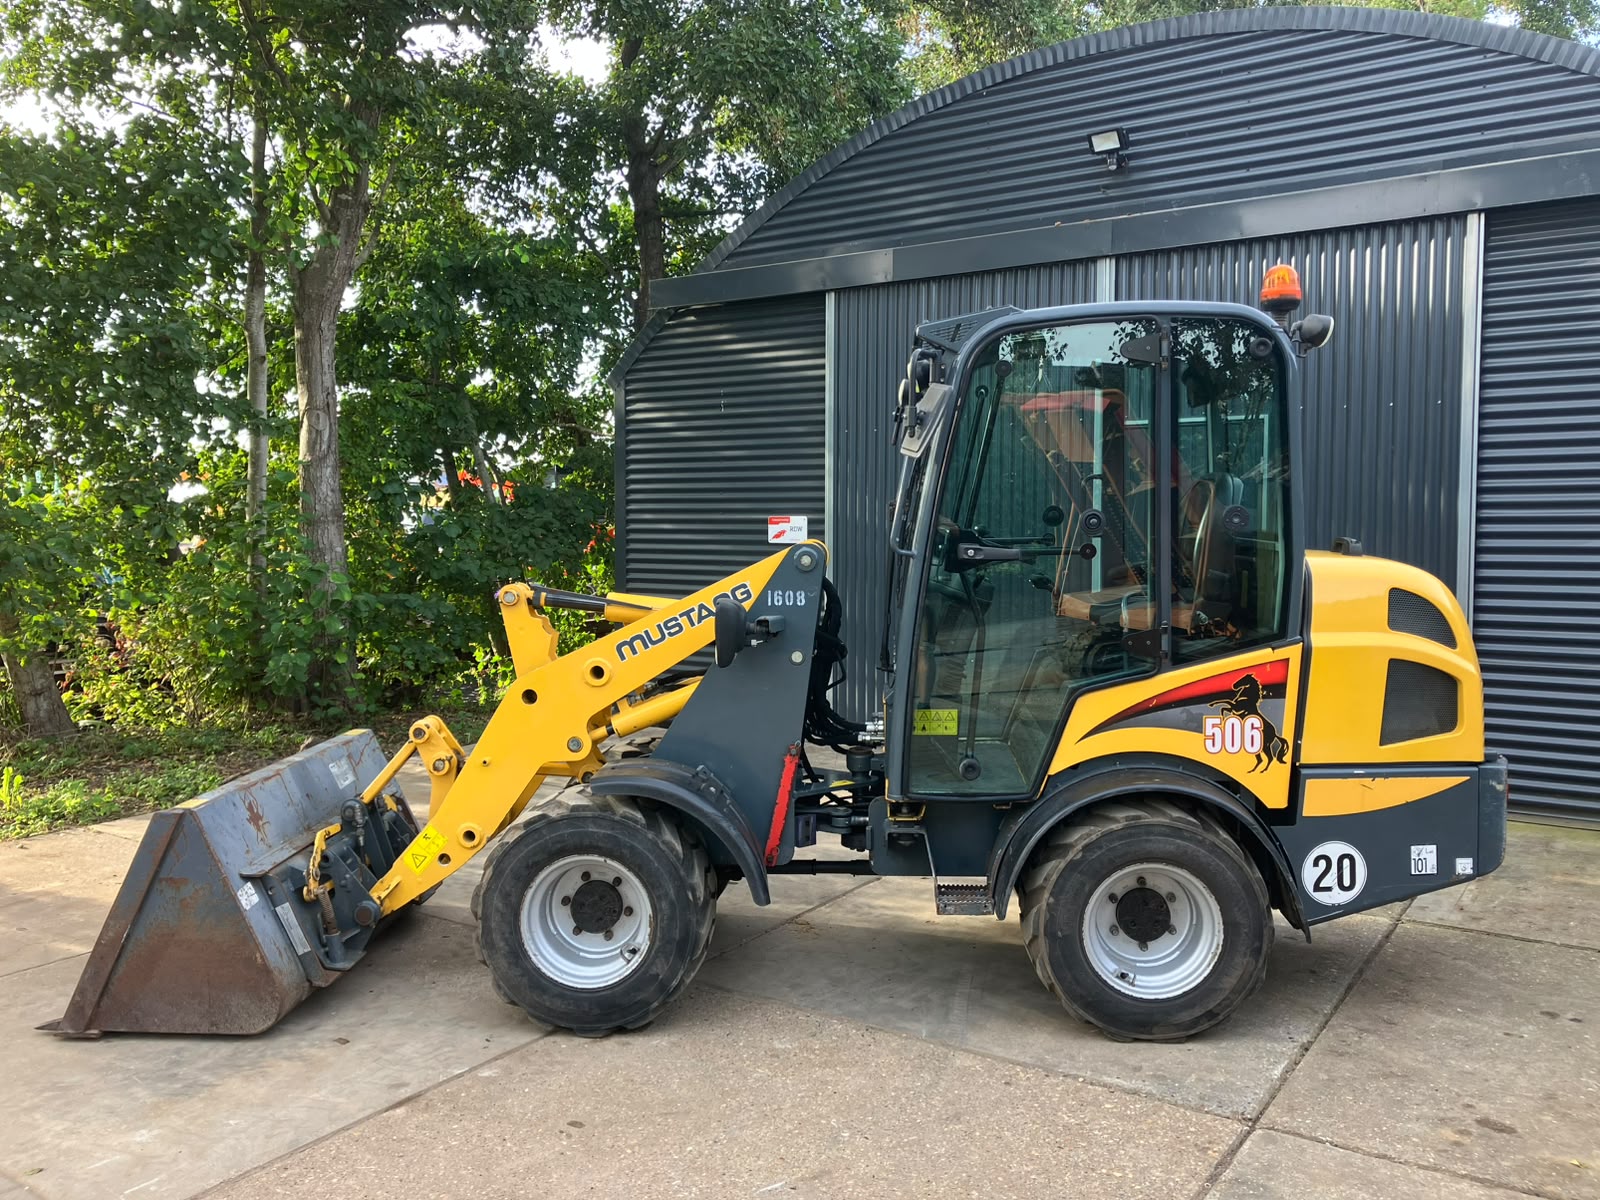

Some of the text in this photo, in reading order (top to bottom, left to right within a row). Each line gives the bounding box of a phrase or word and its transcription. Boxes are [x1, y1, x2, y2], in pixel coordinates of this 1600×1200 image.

[767, 590, 806, 606] 1608
[1203, 715, 1264, 755] 506
[1312, 853, 1356, 893] 20
[1412, 857, 1428, 873] 101
